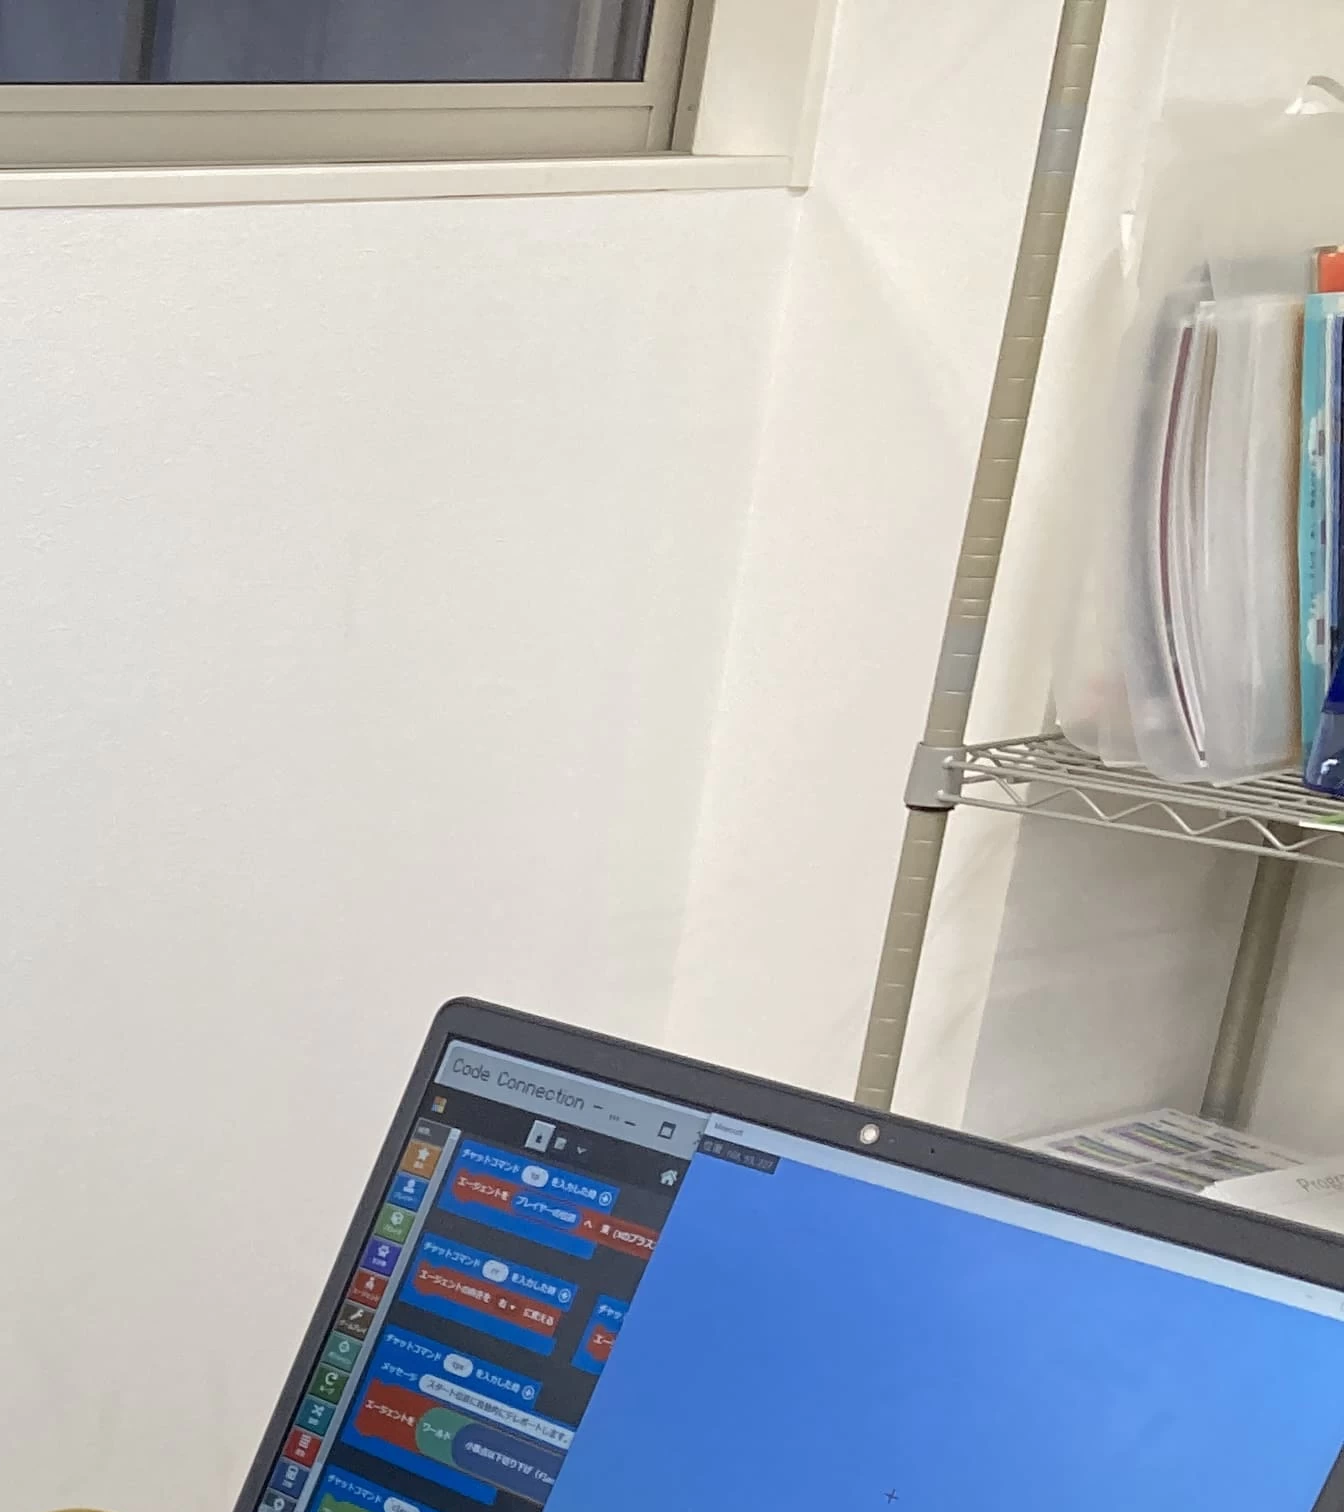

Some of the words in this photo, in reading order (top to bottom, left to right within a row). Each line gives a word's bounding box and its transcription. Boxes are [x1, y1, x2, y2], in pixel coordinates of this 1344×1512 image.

[452, 1058, 490, 1082] Code
[497, 1071, 585, 1111] Connection
[461, 1148, 521, 1174] チャットコマンド
[551, 1177, 598, 1201] を入力した時
[456, 1176, 510, 1201] エージェントを
[515, 1195, 577, 1224] プレイヤーの位置
[422, 1241, 481, 1268] チャットコマンド
[510, 1271, 557, 1296] を入力した時
[380, 1361, 419, 1382] メッセージ
[384, 1333, 442, 1361] チャットコマンド
[475, 1369, 521, 1393] を入力した時
[364, 1399, 416, 1427] エージェントを
[327, 1474, 382, 1503] チャットコマンド
